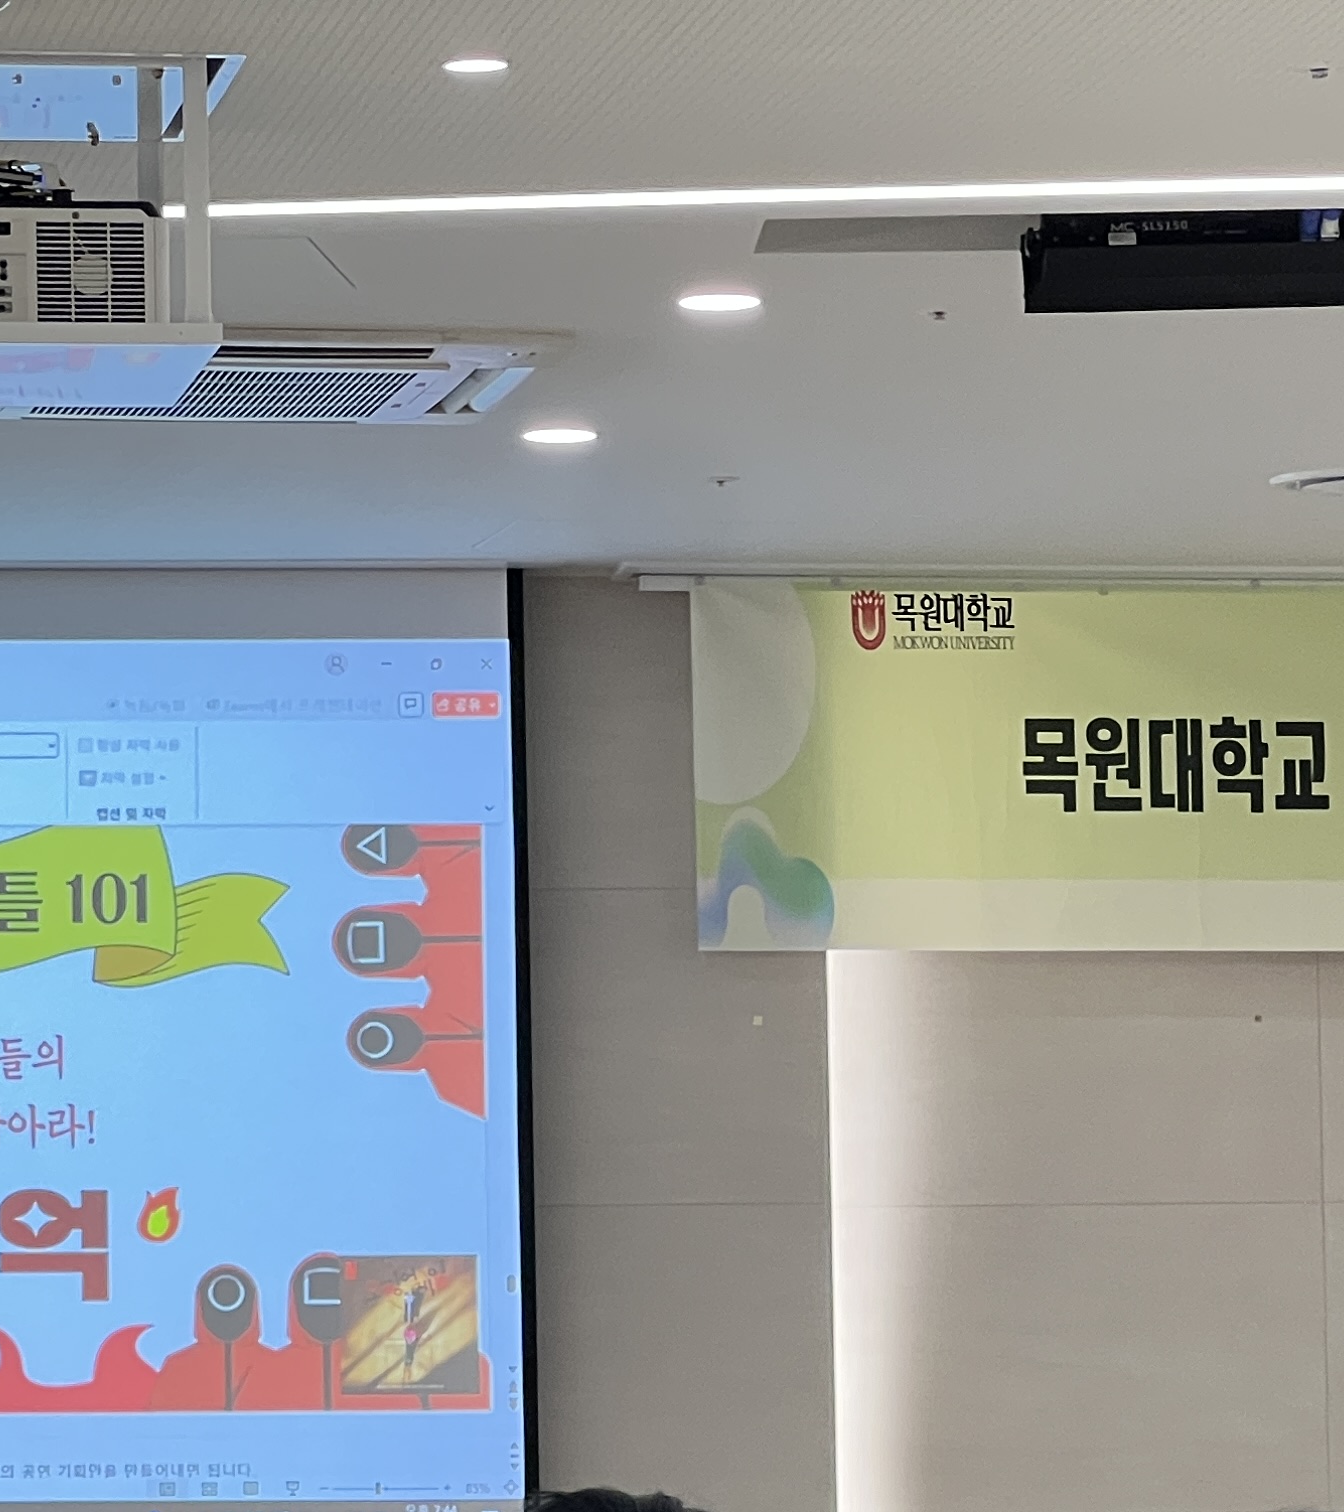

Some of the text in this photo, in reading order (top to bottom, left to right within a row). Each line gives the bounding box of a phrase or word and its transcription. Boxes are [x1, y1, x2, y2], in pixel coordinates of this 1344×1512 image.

[892, 593, 1015, 632] 목원대학교
[893, 636, 1015, 650] MOKWON UNIVERSITY
[1022, 716, 1330, 813] 목원대학교
[66, 872, 150, 926] 101
